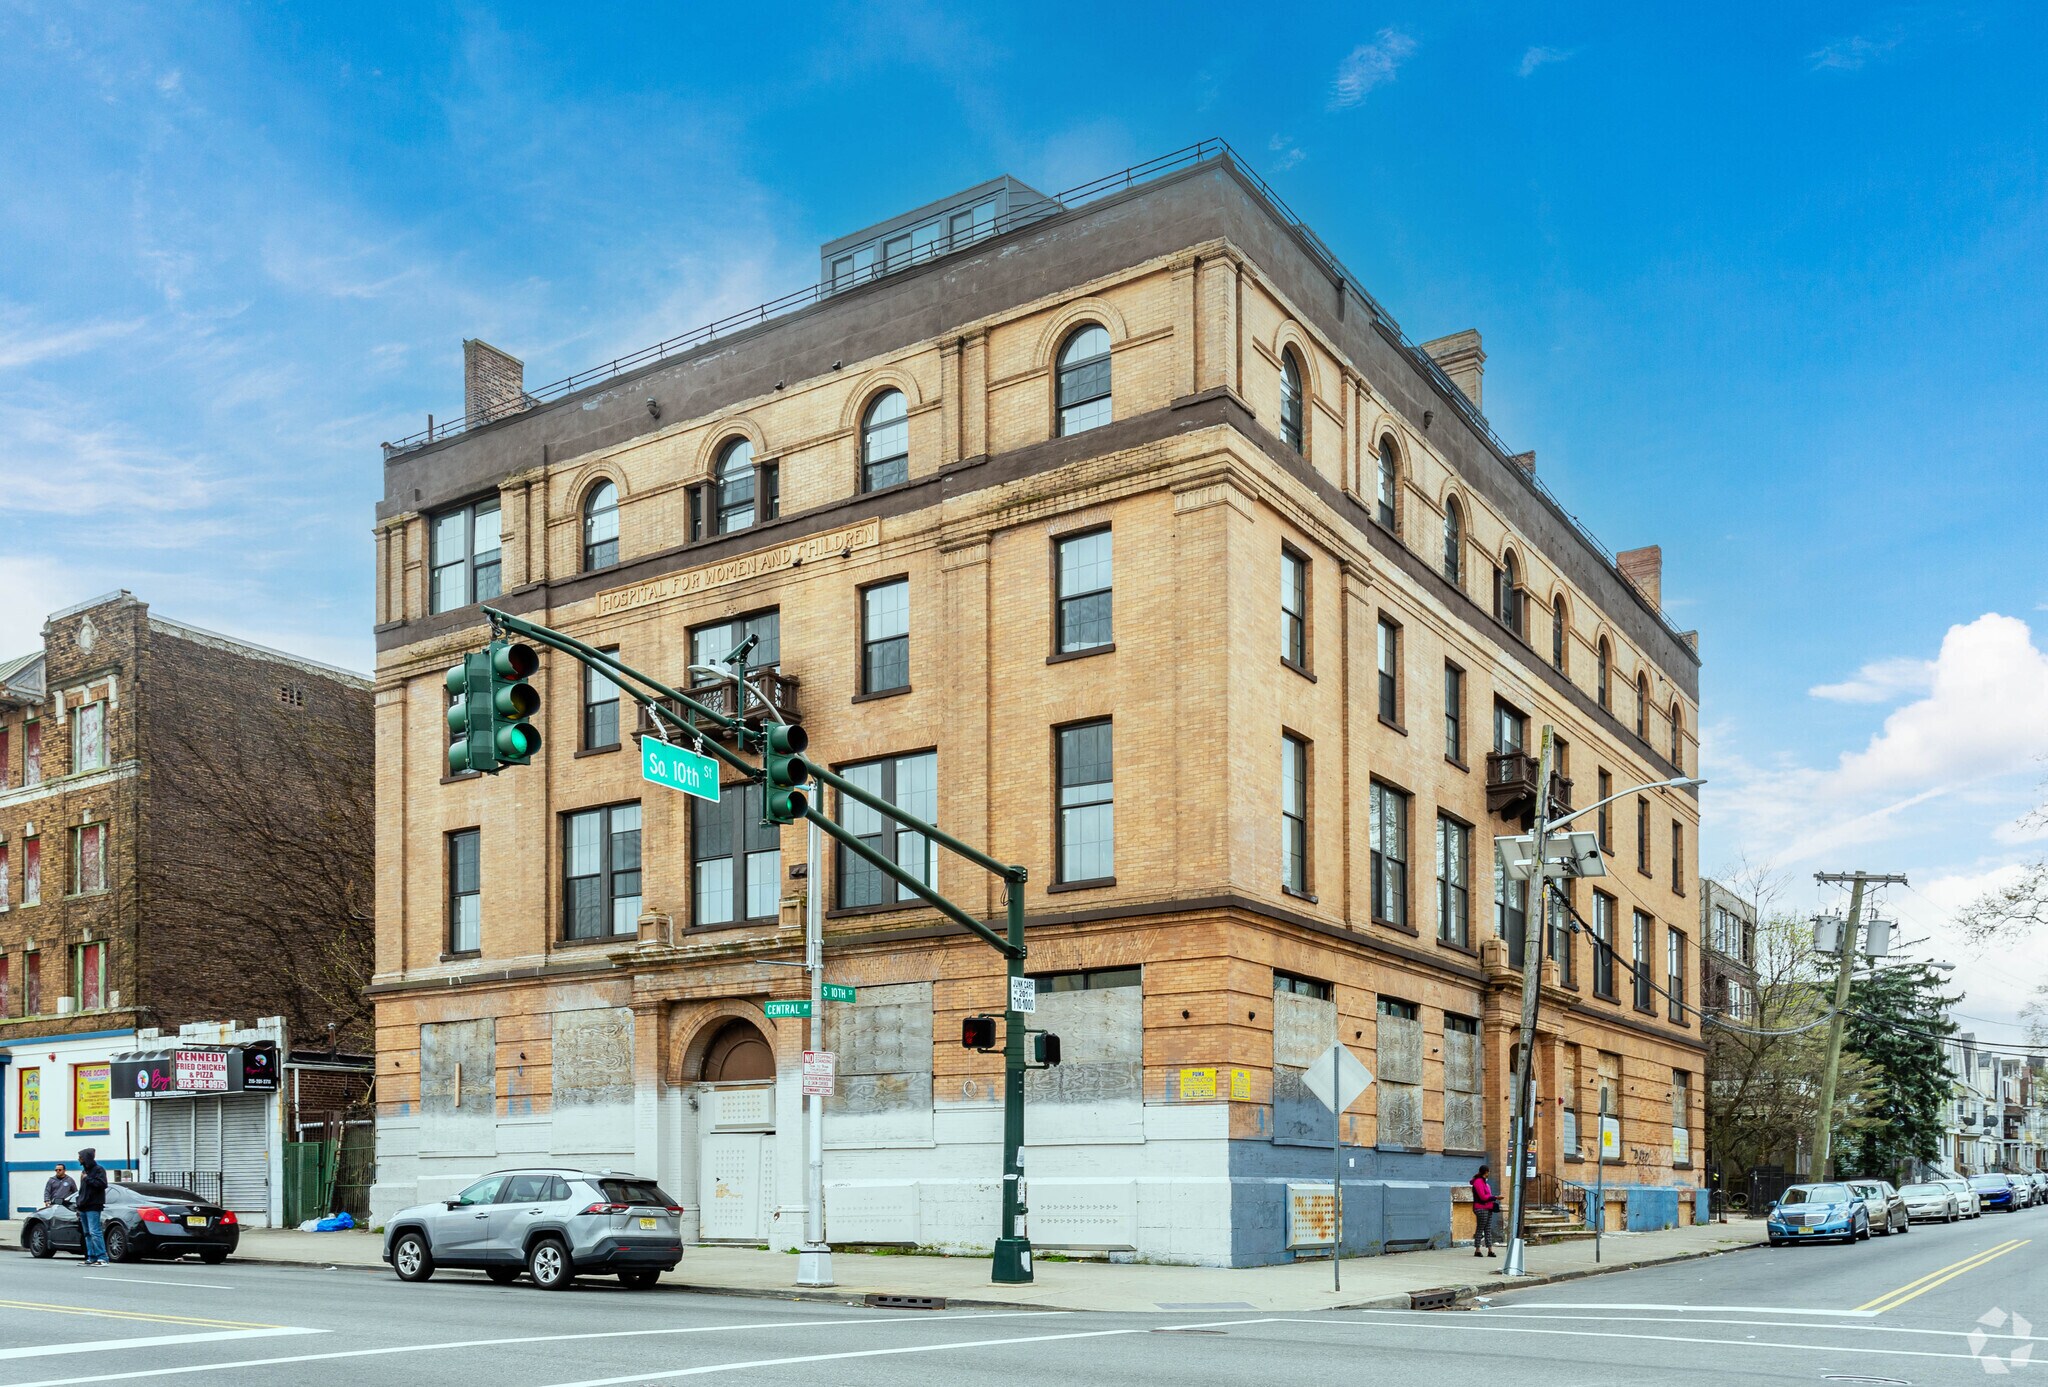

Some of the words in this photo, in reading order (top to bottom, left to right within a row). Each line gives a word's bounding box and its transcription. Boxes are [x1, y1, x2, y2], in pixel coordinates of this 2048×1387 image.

[602, 582, 667, 613] HOSPITAL
[672, 572, 700, 595] FOR
[705, 558, 757, 586] WOMEN
[760, 546, 792, 571] AND
[797, 524, 875, 561] CHILDREN
[649, 752, 669, 779] So.
[673, 760, 700, 789] 10th
[703, 765, 713, 780] St
[1013, 979, 1024, 989] JUNK
[1024, 981, 1034, 990] CARS
[823, 987, 828, 997] S
[831, 987, 846, 999] 10TH
[767, 1004, 800, 1015] CENTRAL
[176, 1052, 225, 1062] KENNEDY
[804, 1053, 814, 1064] NO
